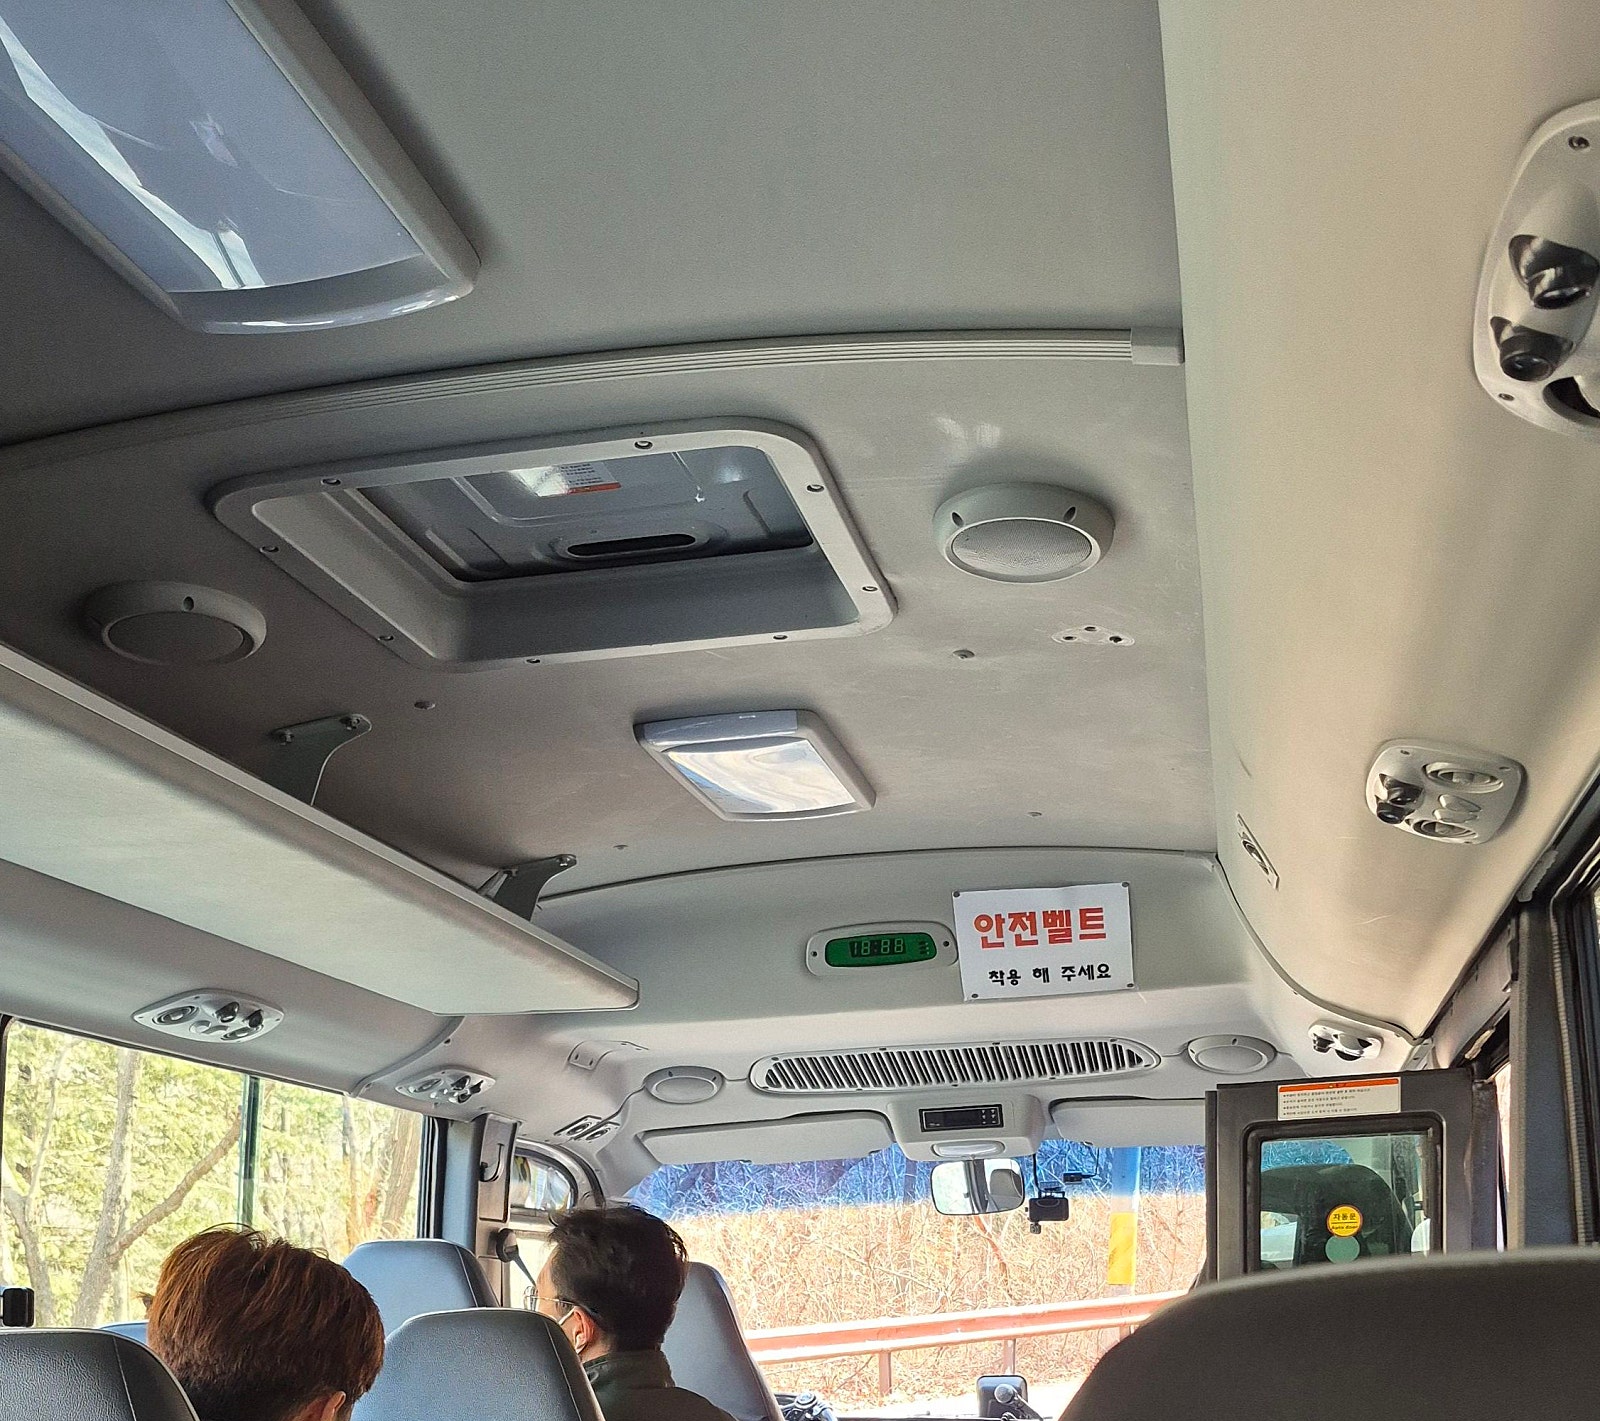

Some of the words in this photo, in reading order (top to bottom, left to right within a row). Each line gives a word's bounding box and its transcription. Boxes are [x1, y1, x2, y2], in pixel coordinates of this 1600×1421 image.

[973, 907, 1107, 950] 안전벨트
[988, 969, 1022, 986] 착용
[1032, 967, 1050, 983] 해
[1061, 964, 1112, 982] 주세요
